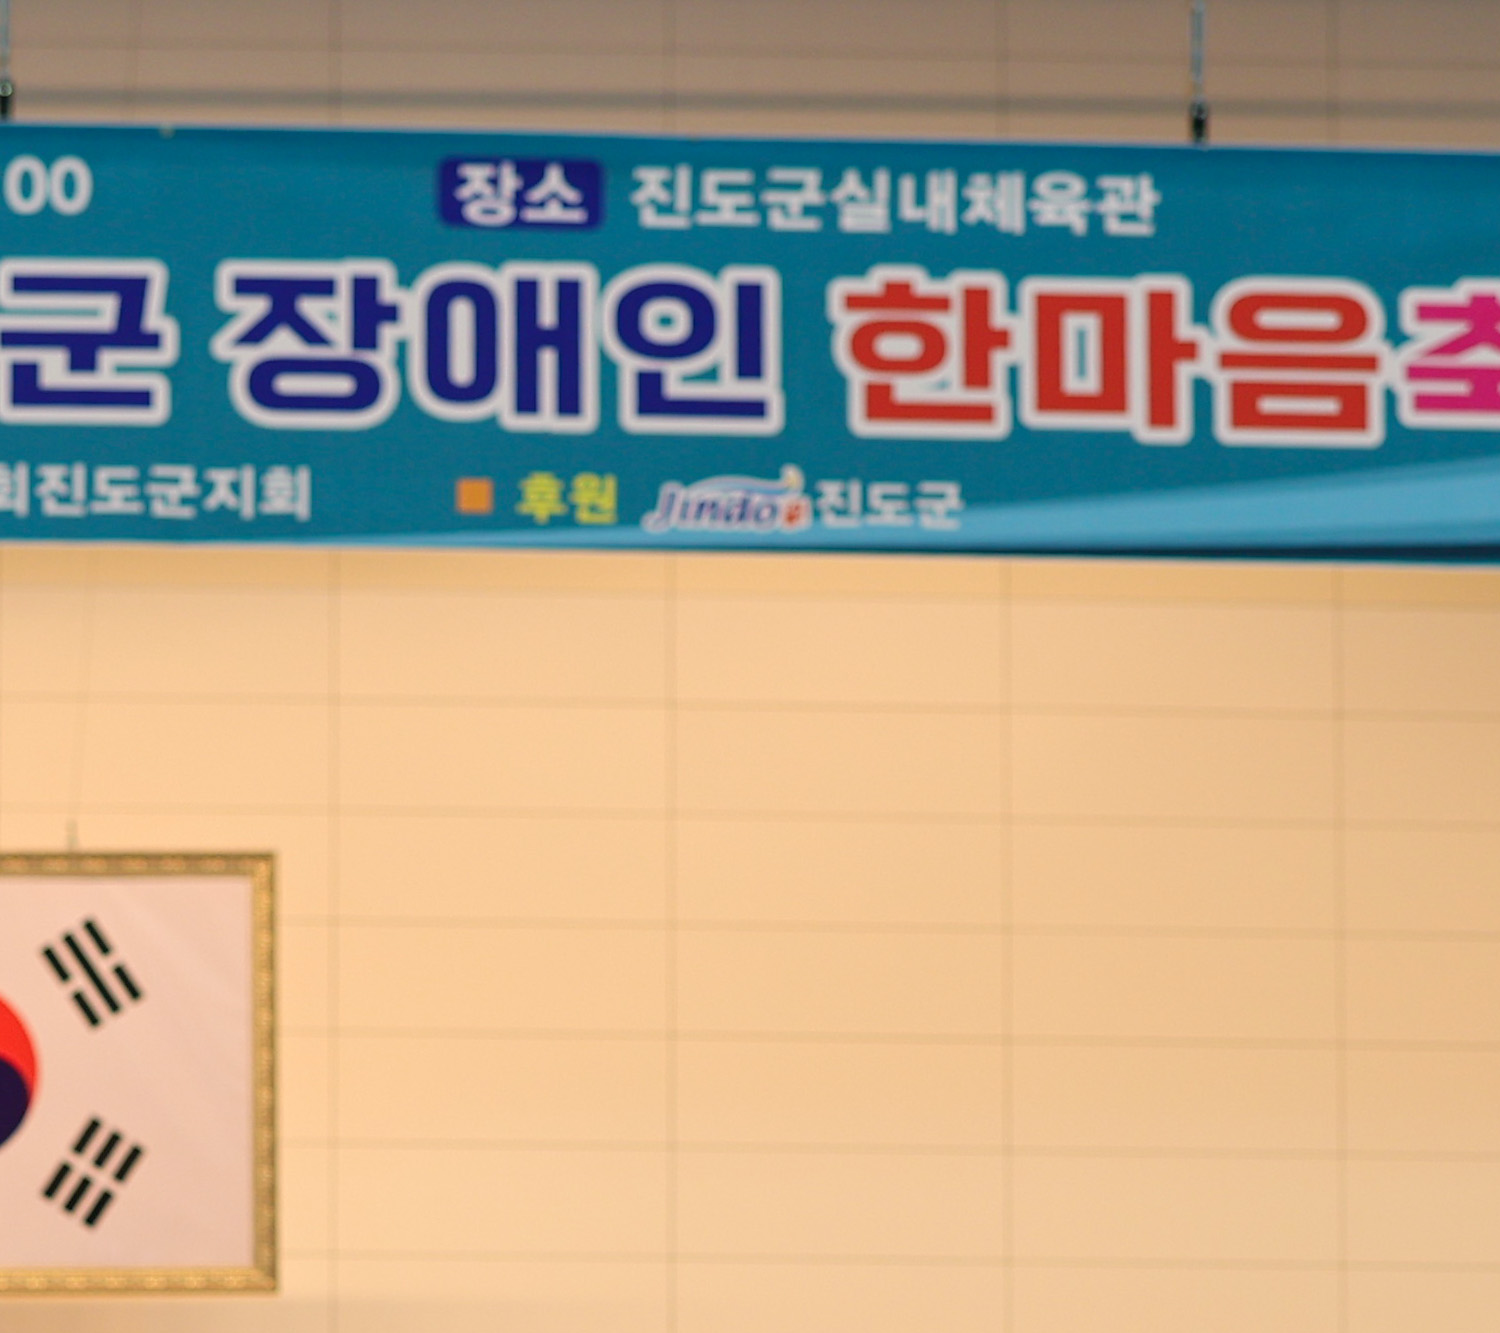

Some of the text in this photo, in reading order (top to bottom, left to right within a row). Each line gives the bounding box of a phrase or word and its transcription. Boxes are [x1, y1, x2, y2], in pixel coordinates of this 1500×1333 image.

[453, 160, 589, 228] 장소
[630, 163, 1162, 236] 진도군실내체육관
[216, 259, 778, 430] 장애인
[517, 472, 619, 527] 후원
[817, 477, 965, 531] 진도군
